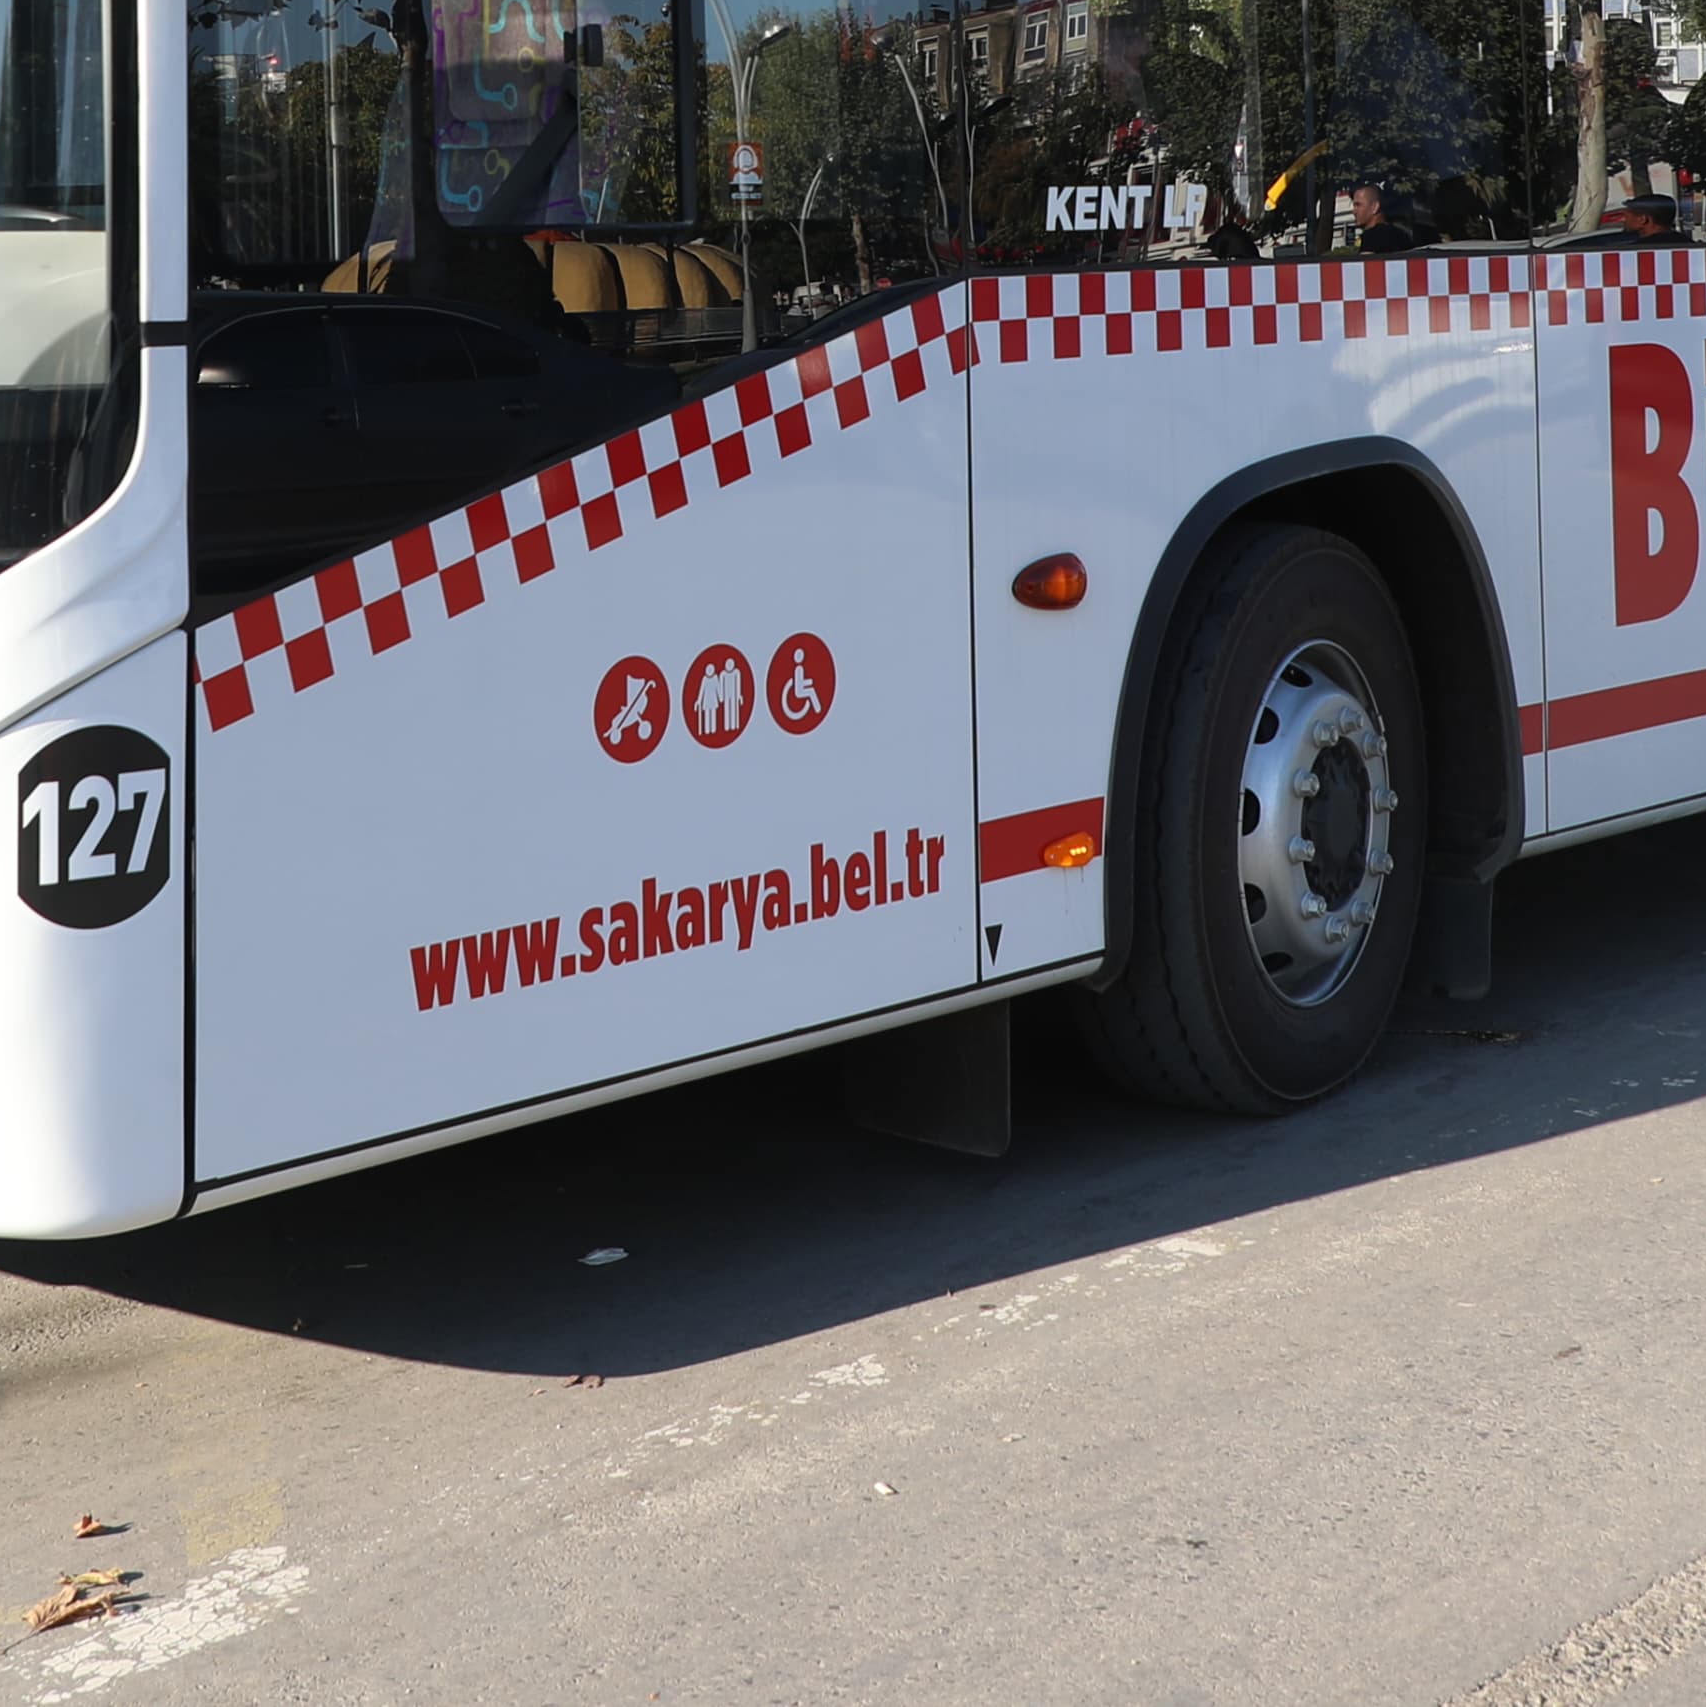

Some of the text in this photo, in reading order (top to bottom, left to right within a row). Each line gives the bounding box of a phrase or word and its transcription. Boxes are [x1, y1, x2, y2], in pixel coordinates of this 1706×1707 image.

[1045, 185, 1152, 232] KENT
[22, 768, 165, 886] 127
[410, 827, 944, 1012] www.sakarya.bel.tr
